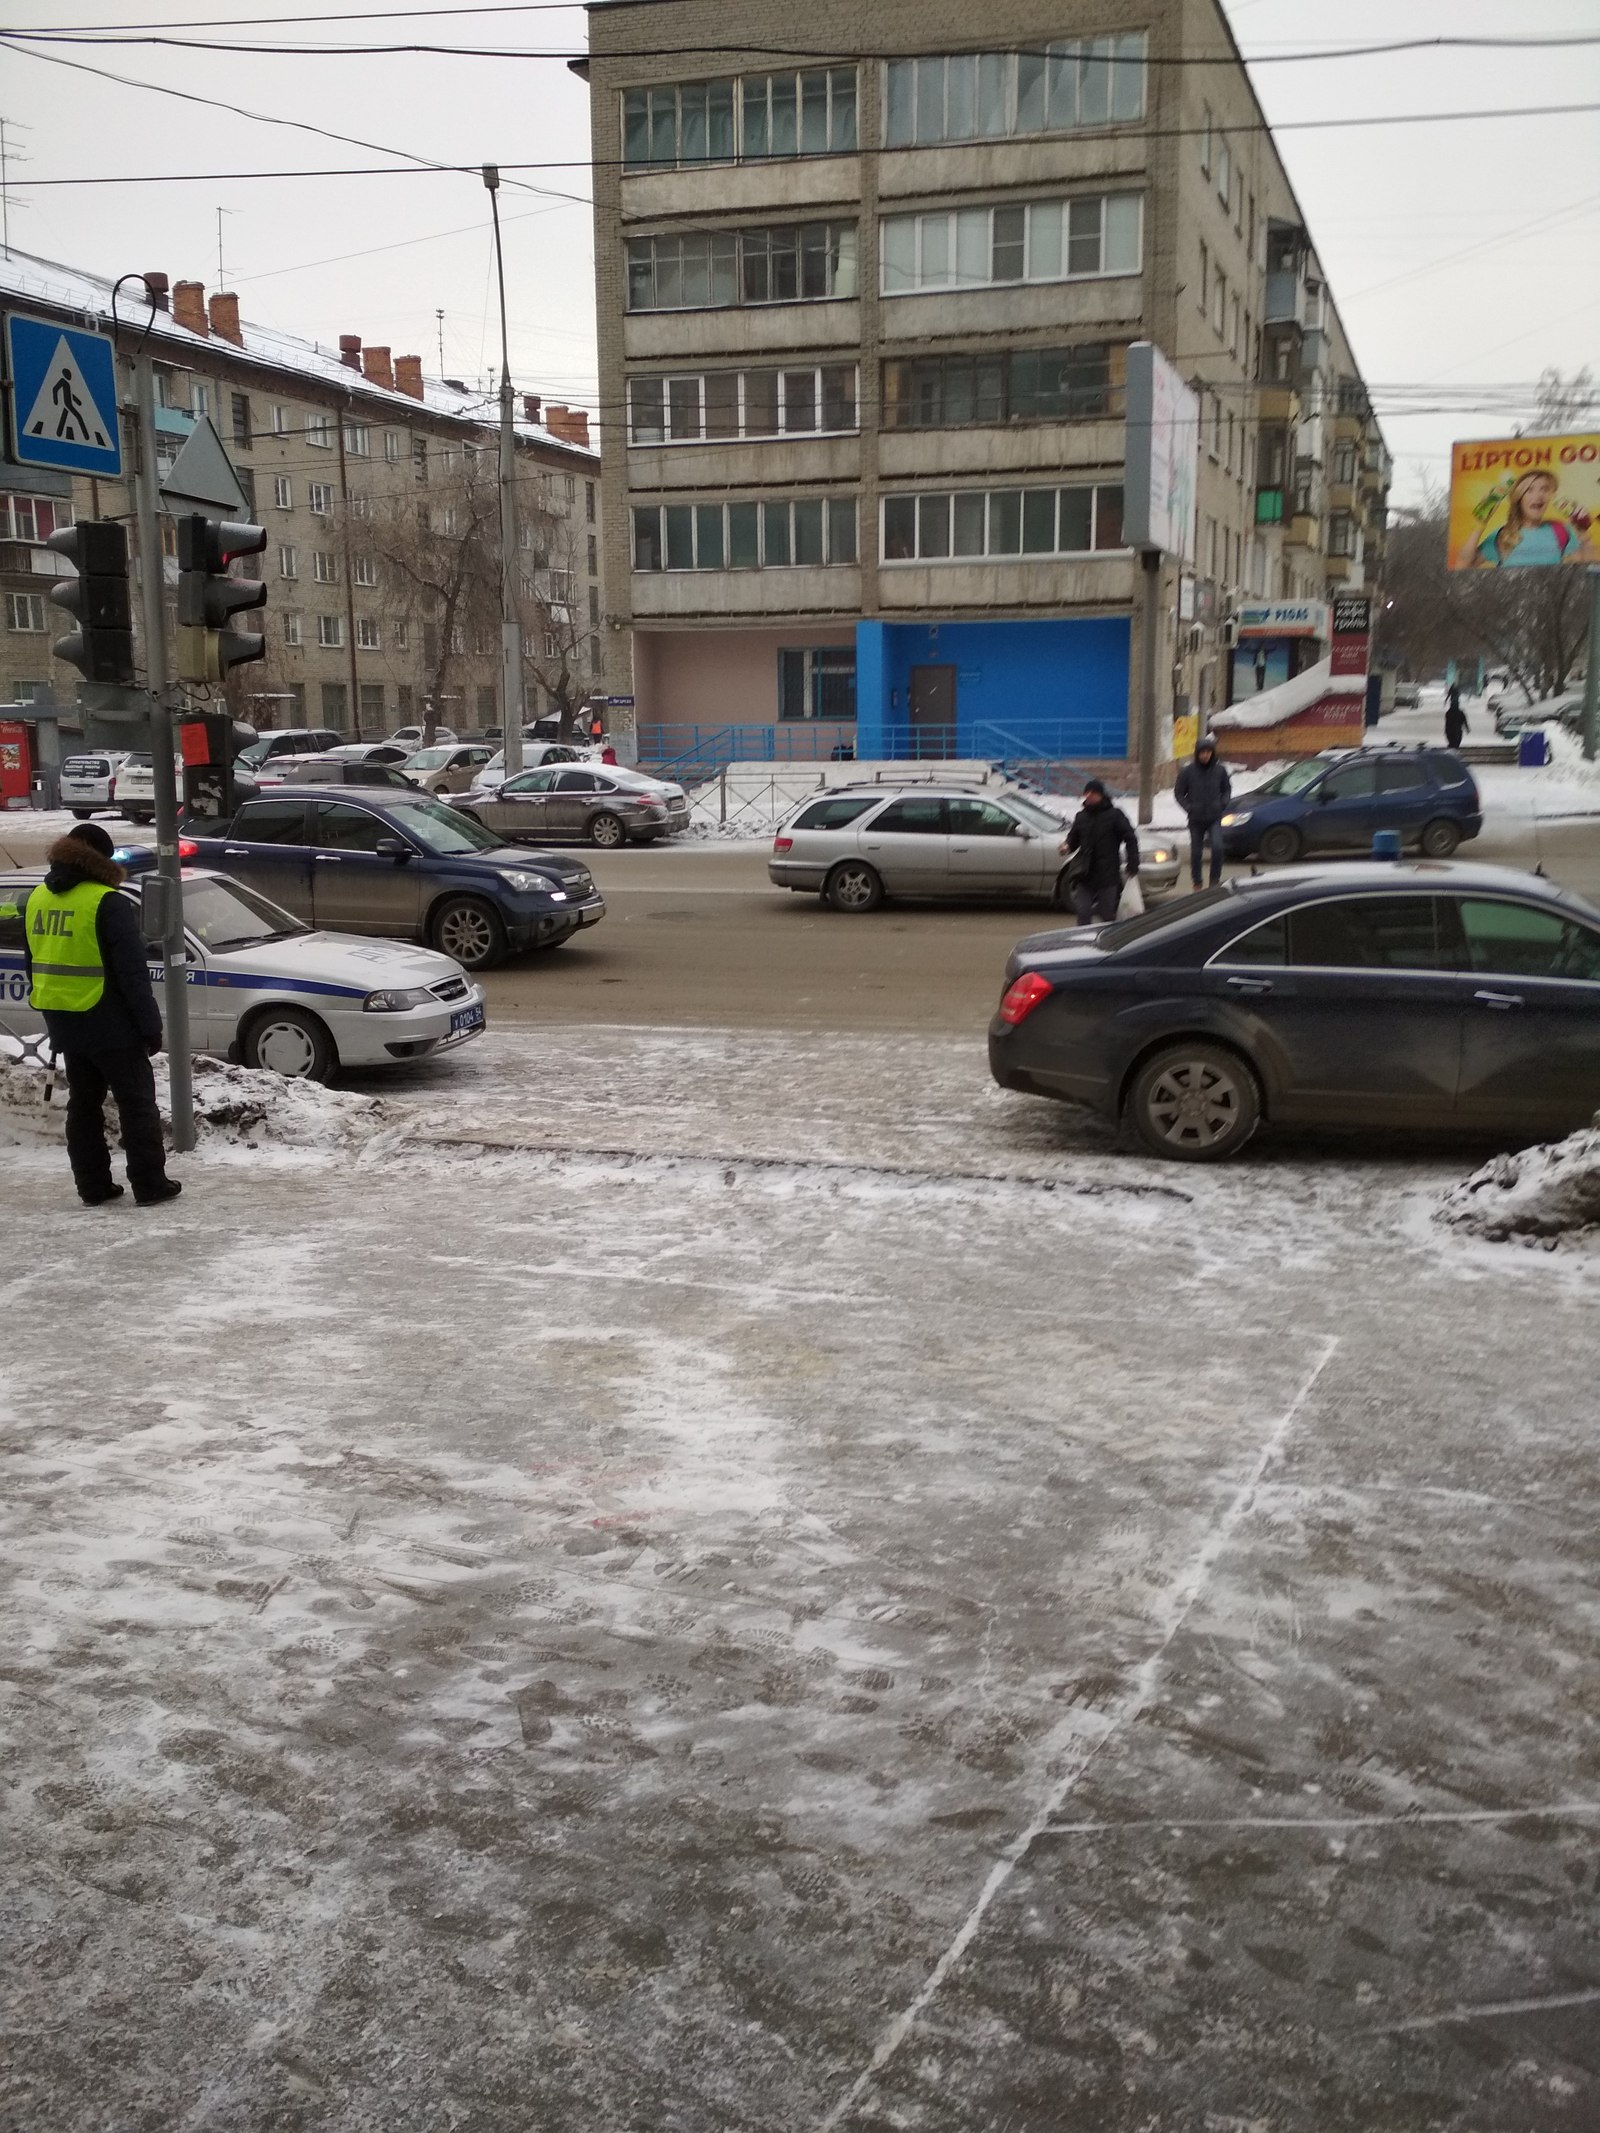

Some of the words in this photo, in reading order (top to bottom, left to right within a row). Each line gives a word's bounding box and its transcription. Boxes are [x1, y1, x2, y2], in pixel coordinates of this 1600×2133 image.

[1461, 447, 1552, 471] LIPTON
[1559, 444, 1600, 463] GO
[32, 909, 75, 937] ДПС
